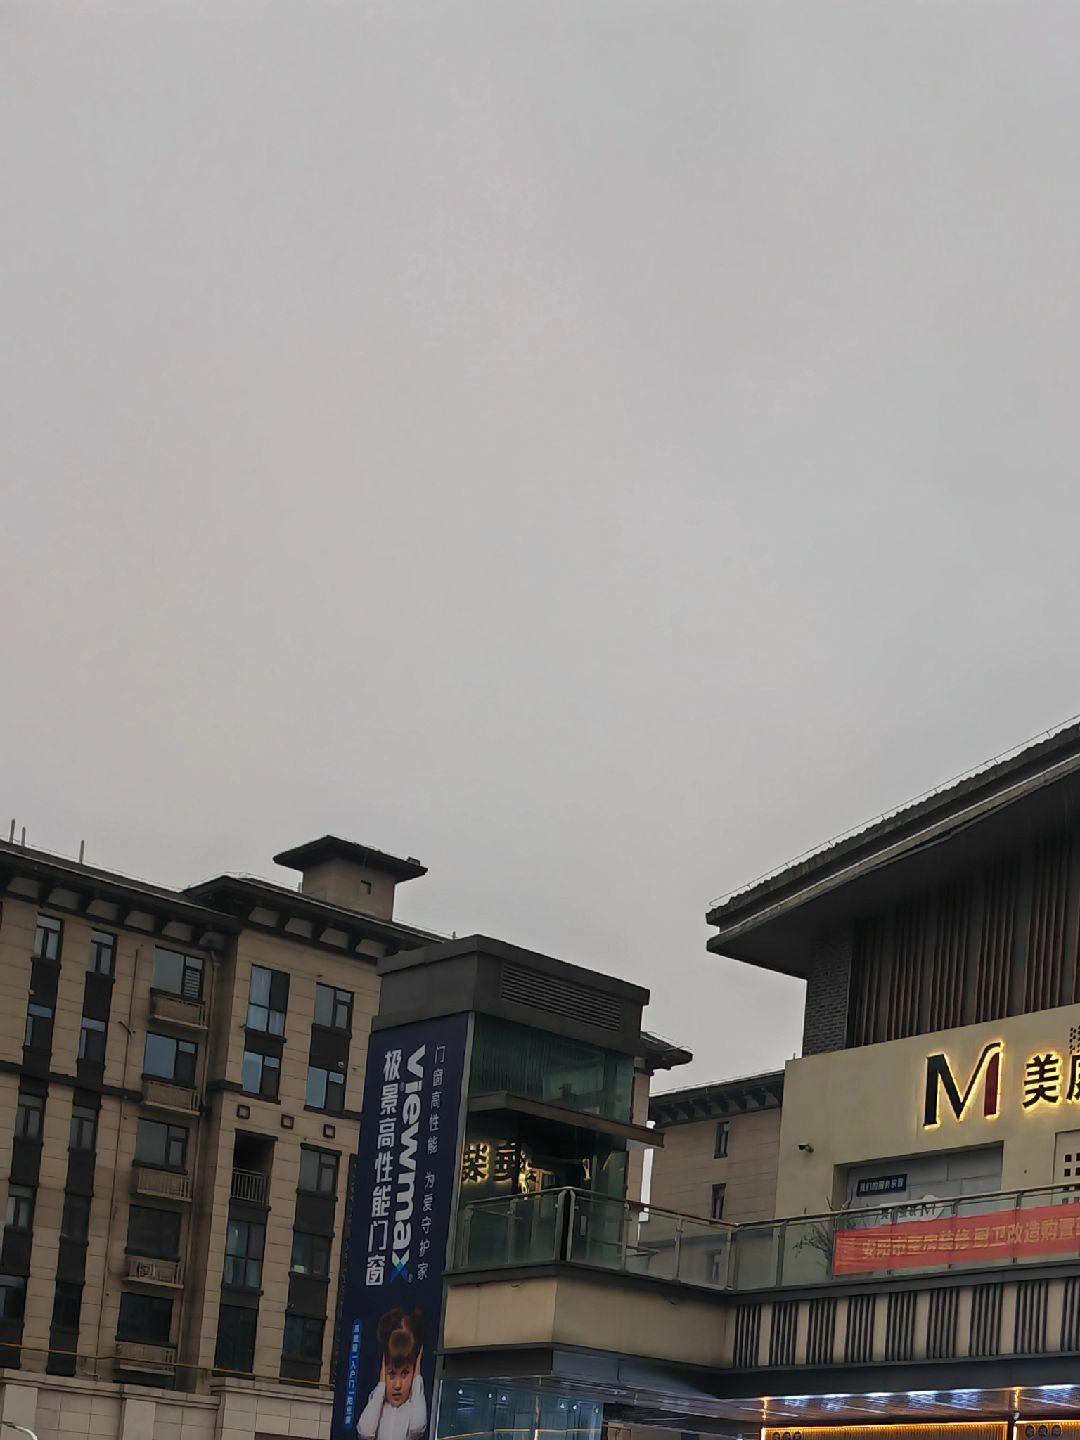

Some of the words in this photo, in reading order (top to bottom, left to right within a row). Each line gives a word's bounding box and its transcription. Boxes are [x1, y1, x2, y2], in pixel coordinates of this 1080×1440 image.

[427, 1044, 446, 1155] 门窗高性能
[365, 1048, 402, 1287] 极景高性能门窗
[416, 1170, 436, 1281] 为爱守护家
